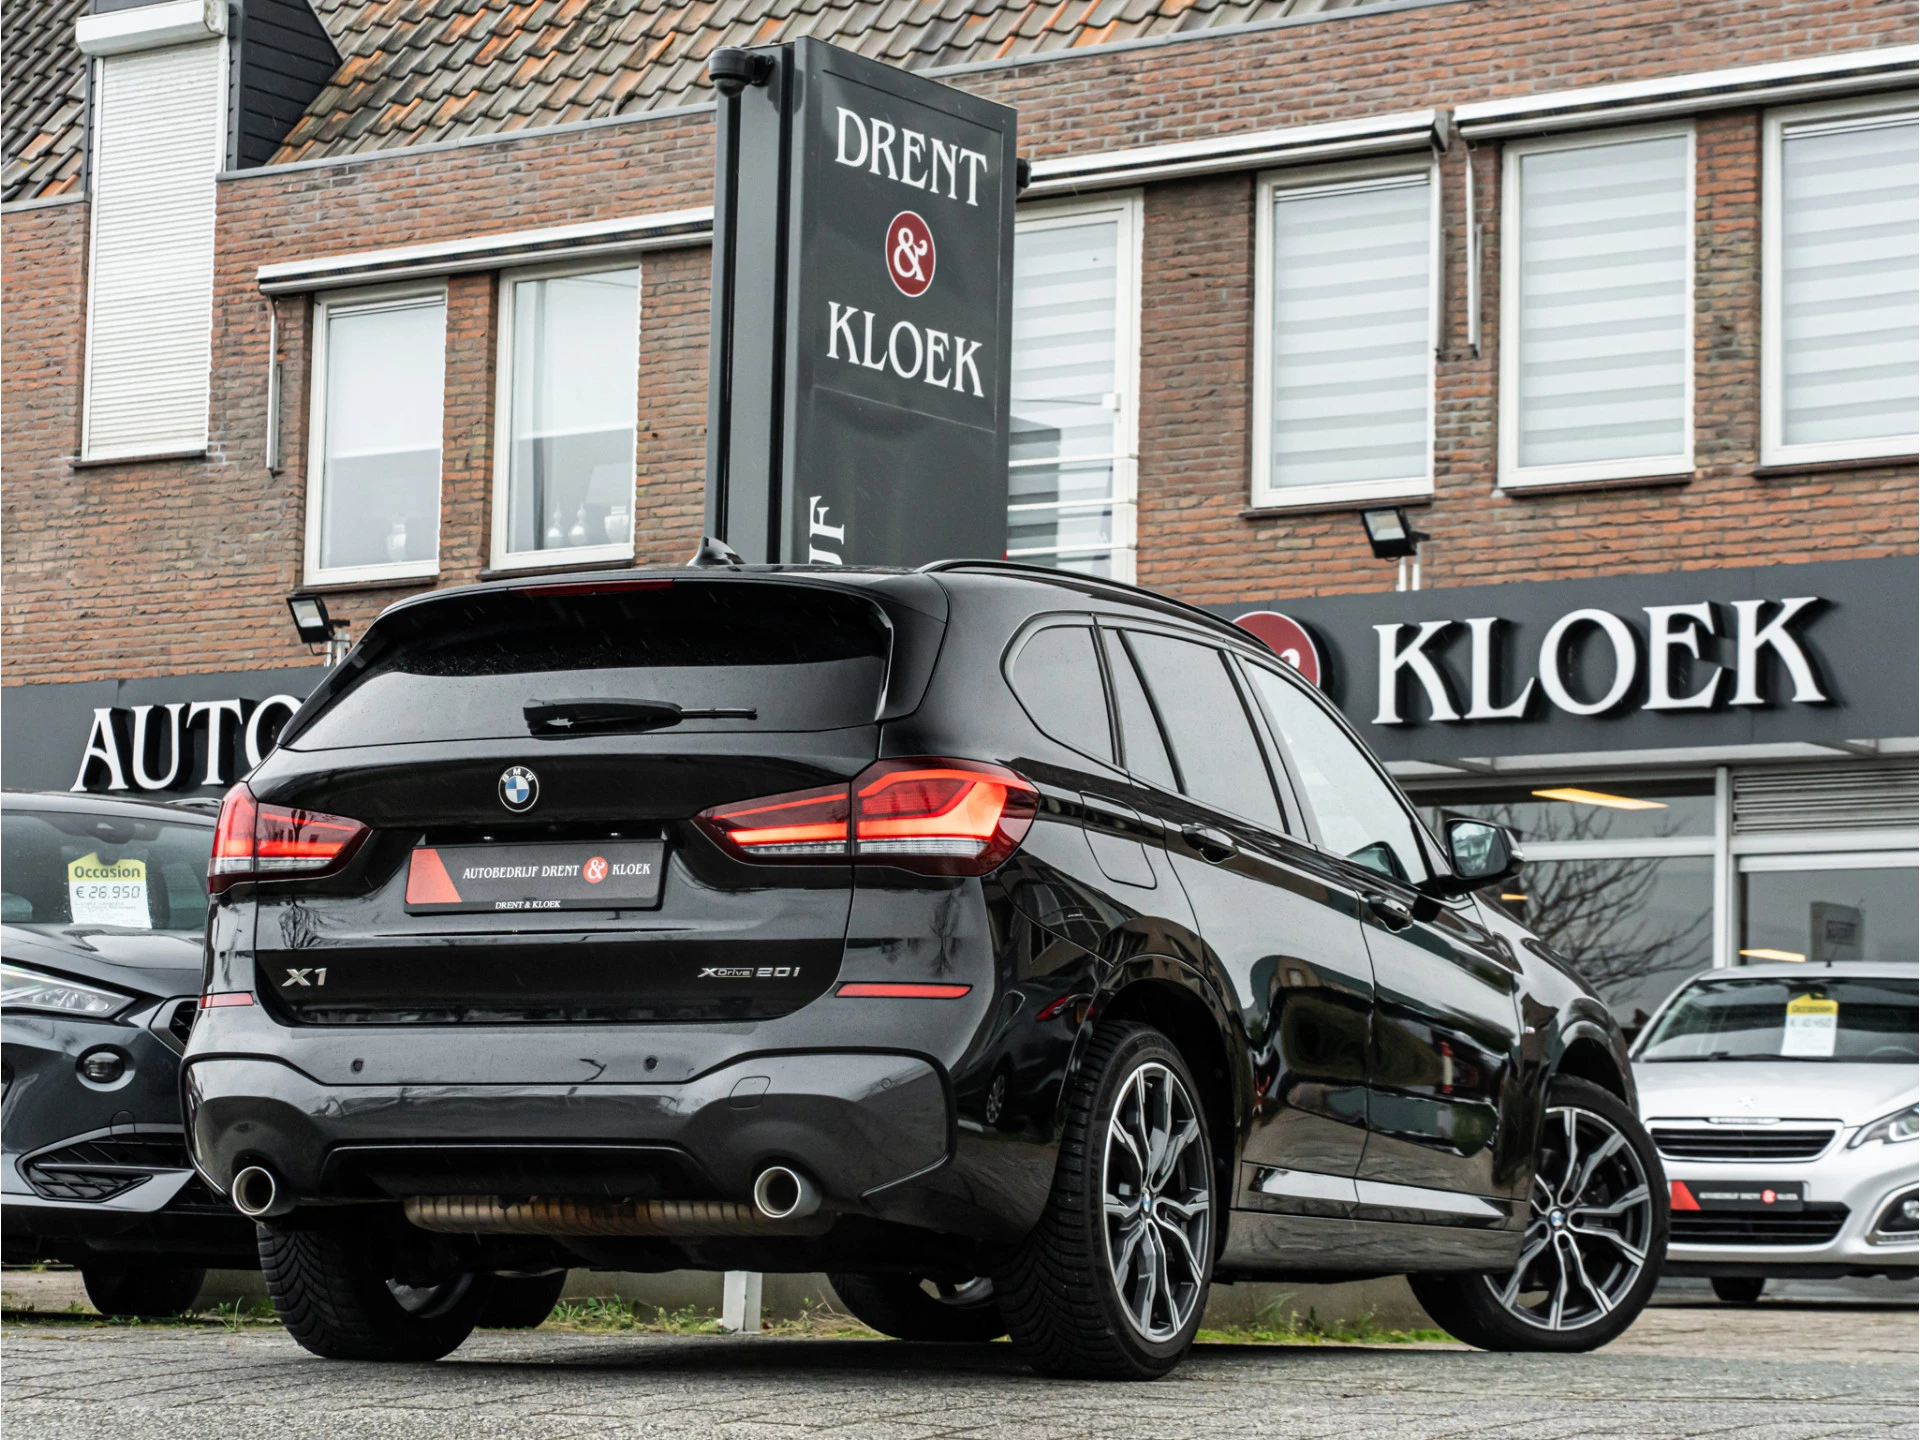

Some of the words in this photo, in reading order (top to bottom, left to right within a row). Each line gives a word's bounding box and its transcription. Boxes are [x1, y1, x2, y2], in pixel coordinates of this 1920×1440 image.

[835, 106, 988, 207] DRENT
[893, 227, 928, 282] &
[827, 301, 985, 398] KLOEK
[1371, 596, 1827, 725] KLOEK
[69, 694, 304, 793] AUTO
[502, 767, 536, 783] BMW
[74, 865, 141, 879] Occasion
[462, 865, 539, 879] AUTOBEDRIJF
[541, 864, 580, 877] DRENT
[587, 859, 606, 880] &
[612, 863, 651, 875] KLOEK
[76, 885, 86, 899] €
[495, 901, 524, 910] DRENT
[524, 900, 531, 909] &
[532, 900, 561, 909] KLOEK
[281, 967, 328, 987] X1
